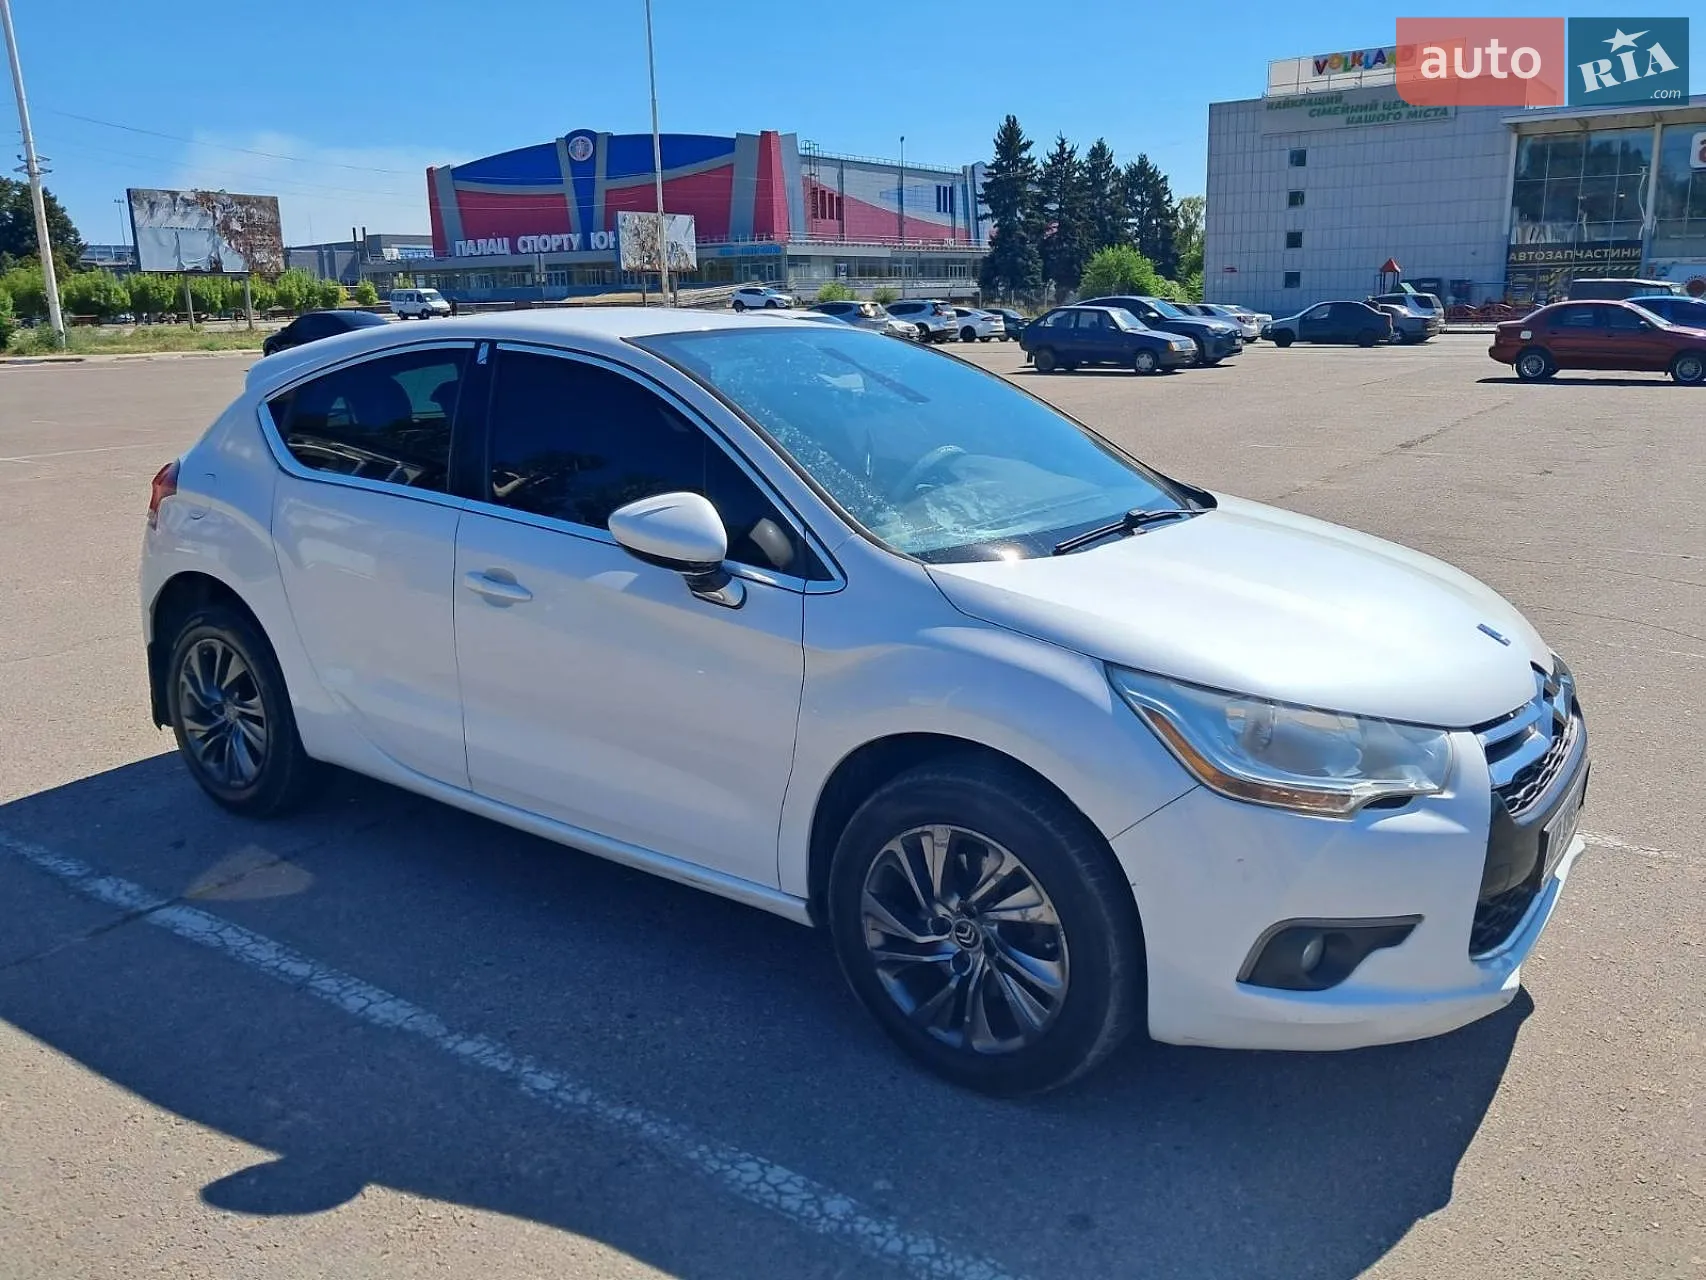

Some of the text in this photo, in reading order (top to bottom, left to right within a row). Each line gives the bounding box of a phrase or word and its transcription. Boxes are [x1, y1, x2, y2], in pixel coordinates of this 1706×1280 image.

[1345, 107, 1448, 125] НАШОГО МІСТА
[455, 237, 510, 256] ПАЛАЦ
[517, 233, 581, 254] СПОРТУ
[1509, 247, 1642, 261] АВТОЗАПЧАСТИНИ
